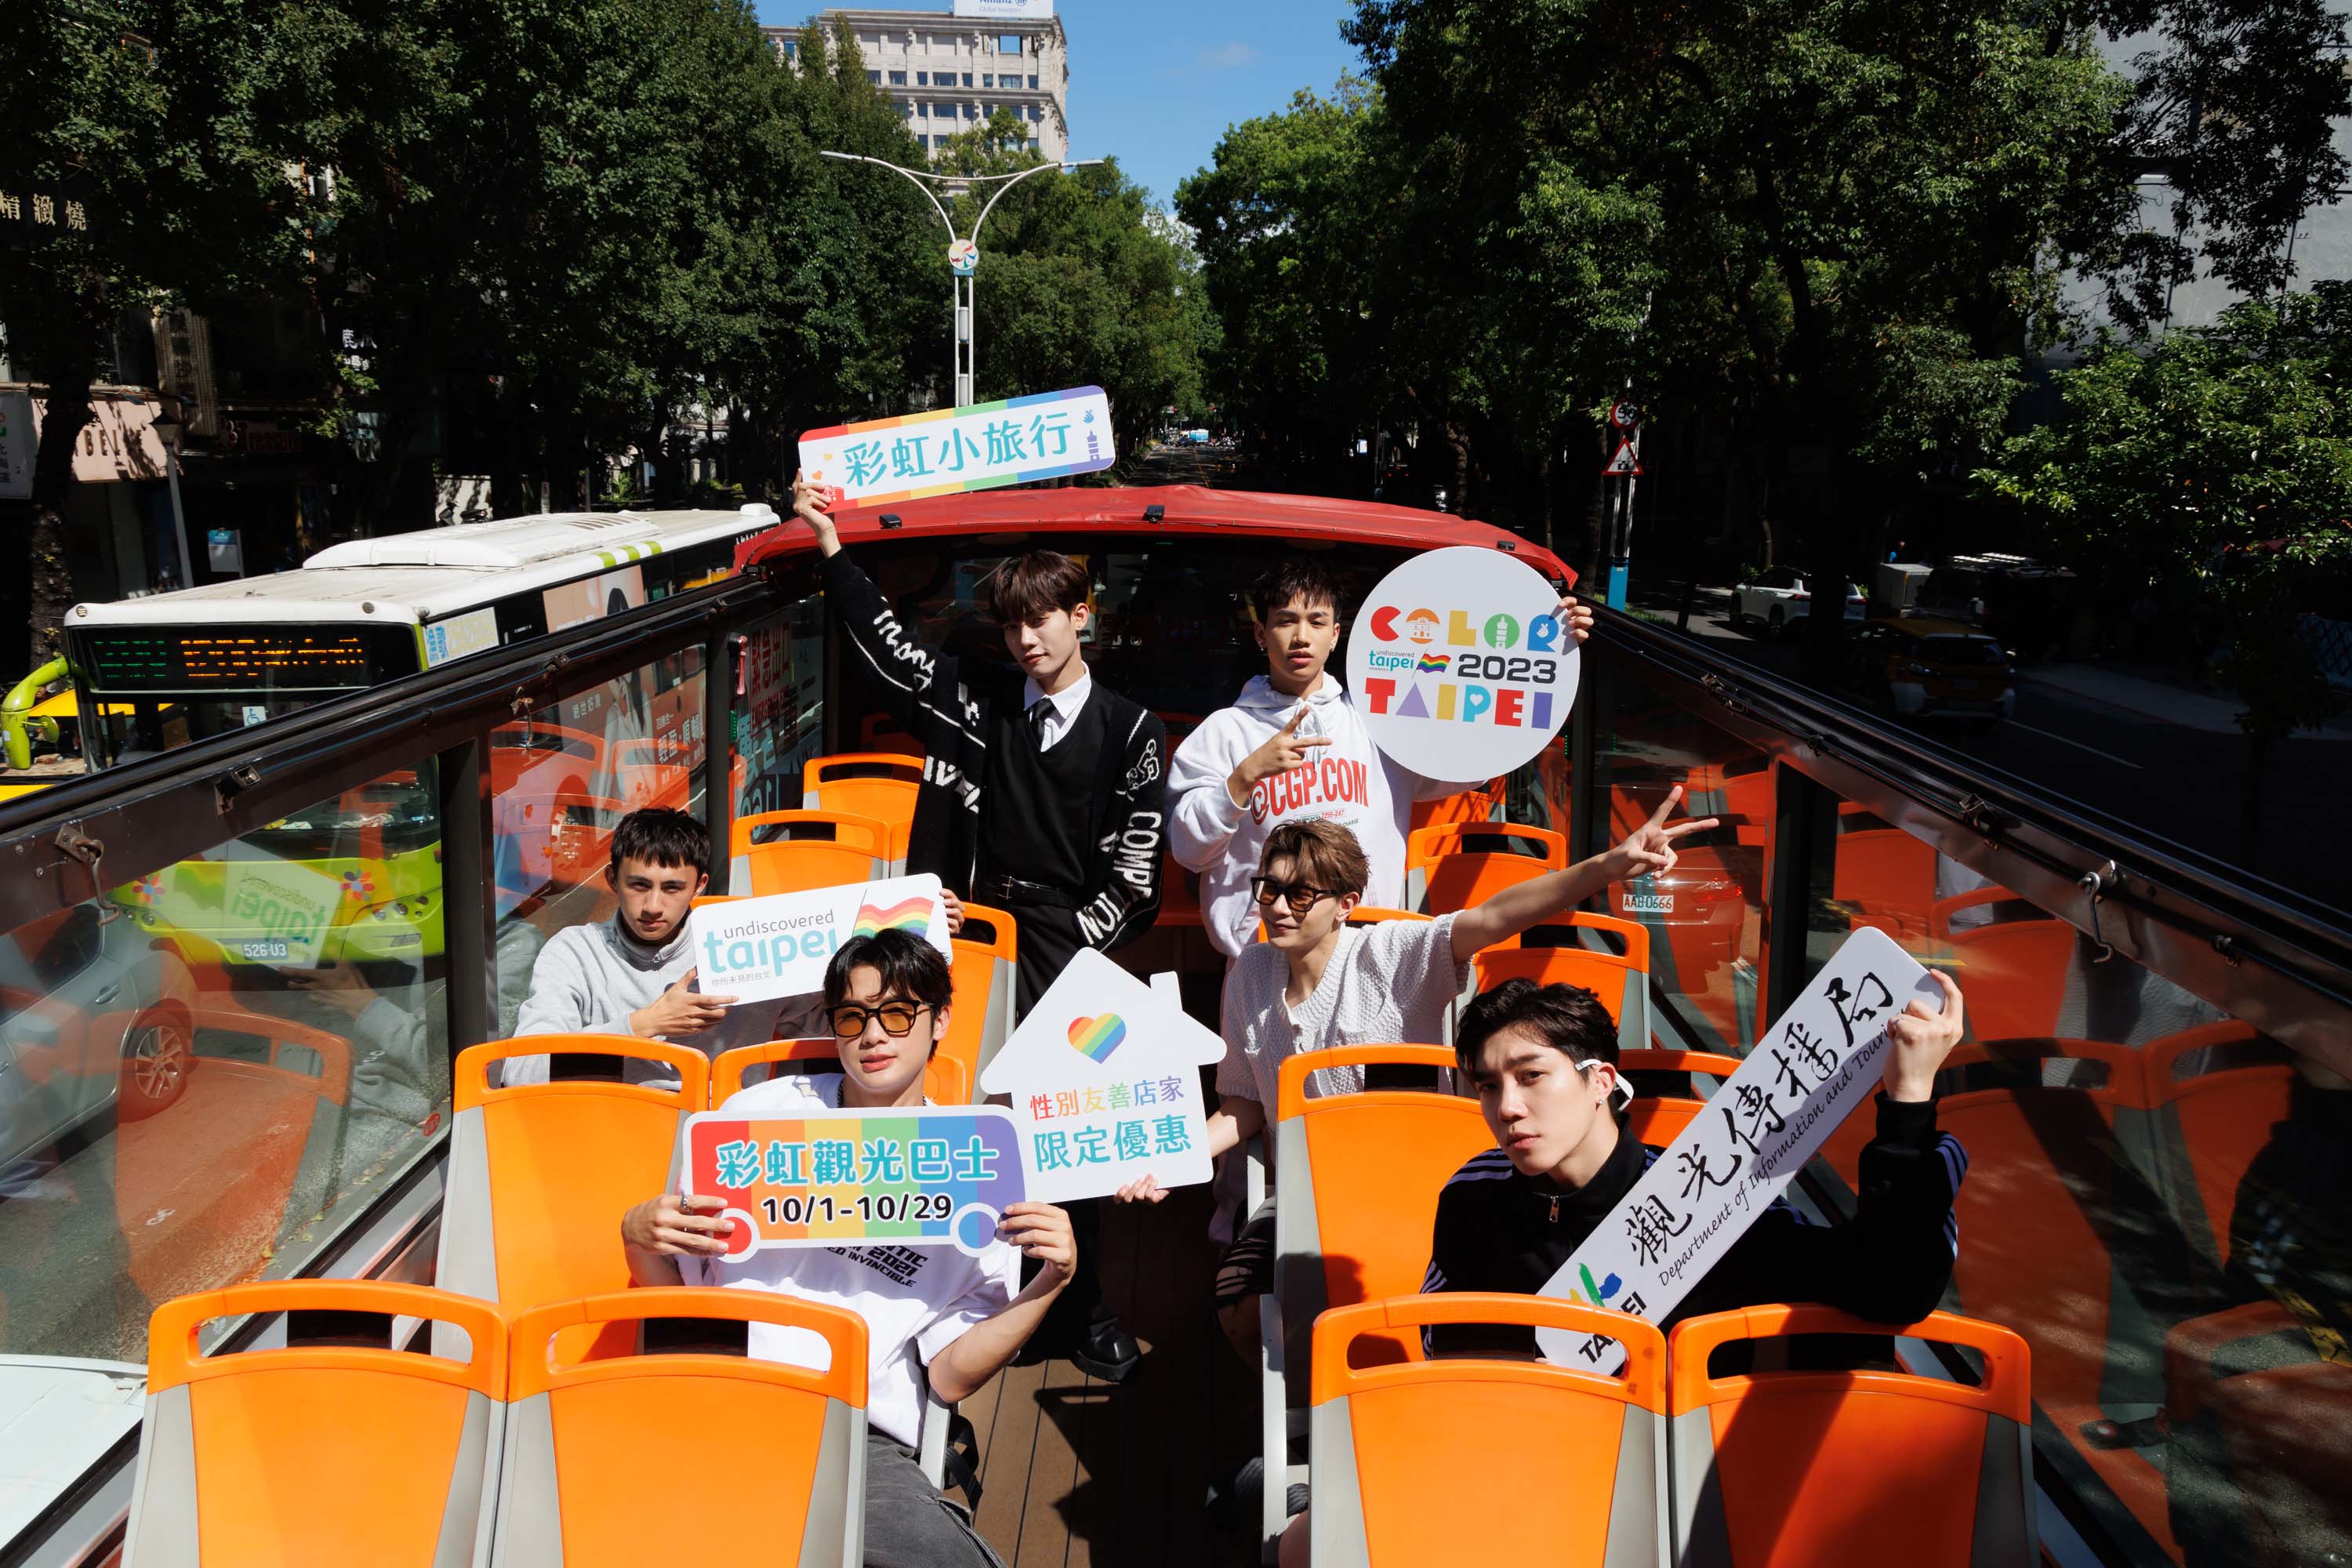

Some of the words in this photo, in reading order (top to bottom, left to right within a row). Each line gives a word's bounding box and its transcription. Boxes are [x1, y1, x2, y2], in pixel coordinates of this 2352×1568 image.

[843, 412, 1071, 487] 彩虹小旅行
[1370, 606, 1559, 652] COLOR
[1369, 650, 1414, 672] taipei
[1376, 649, 1415, 658] undiscovered
[1457, 654, 1557, 684] 2023
[1365, 677, 1553, 730] TAIPEI
[1624, 895, 1672, 909] AAB-0666
[724, 909, 835, 939] undiscovered
[244, 944, 286, 956] 526-U3
[703, 927, 839, 977] taipei
[1029, 1075, 1185, 1121] 性別友善店家
[1626, 971, 1894, 1266] 觀光傳播局
[716, 1134, 1000, 1189] 彩虹觀光巴士
[1033, 1113, 1192, 1173] 限定優惠
[1658, 1202, 1733, 1287] Department
[1734, 1178, 1749, 1211] of
[1748, 1100, 1826, 1189] Information
[1826, 1065, 1853, 1102] and
[761, 1193, 953, 1225] 10/1-10/29
[848, 1251, 916, 1287] INVINCIBLE
[866, 1247, 918, 1277] 2021
